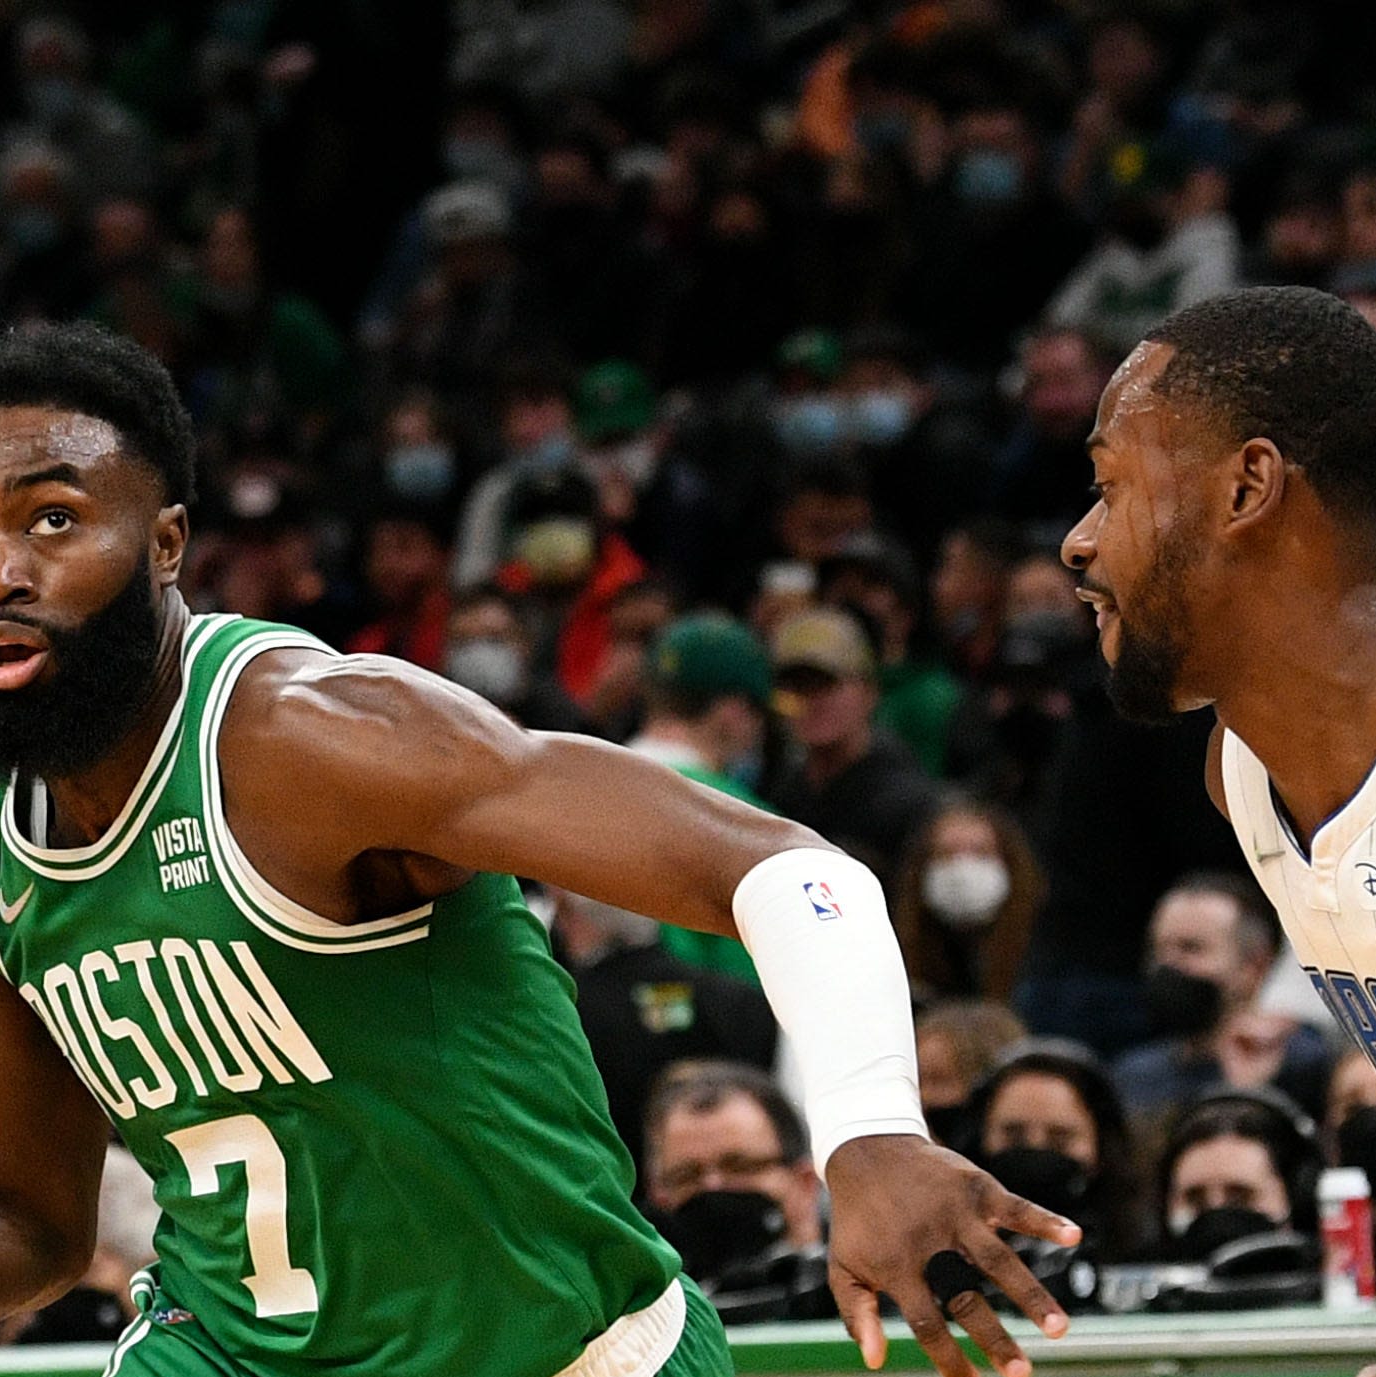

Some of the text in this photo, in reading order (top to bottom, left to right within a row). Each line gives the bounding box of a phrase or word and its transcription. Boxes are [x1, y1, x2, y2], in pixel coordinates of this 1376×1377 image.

[151, 816, 206, 863] VISTA
[159, 855, 210, 893] PRINT
[163, 1114, 319, 1318] 7
